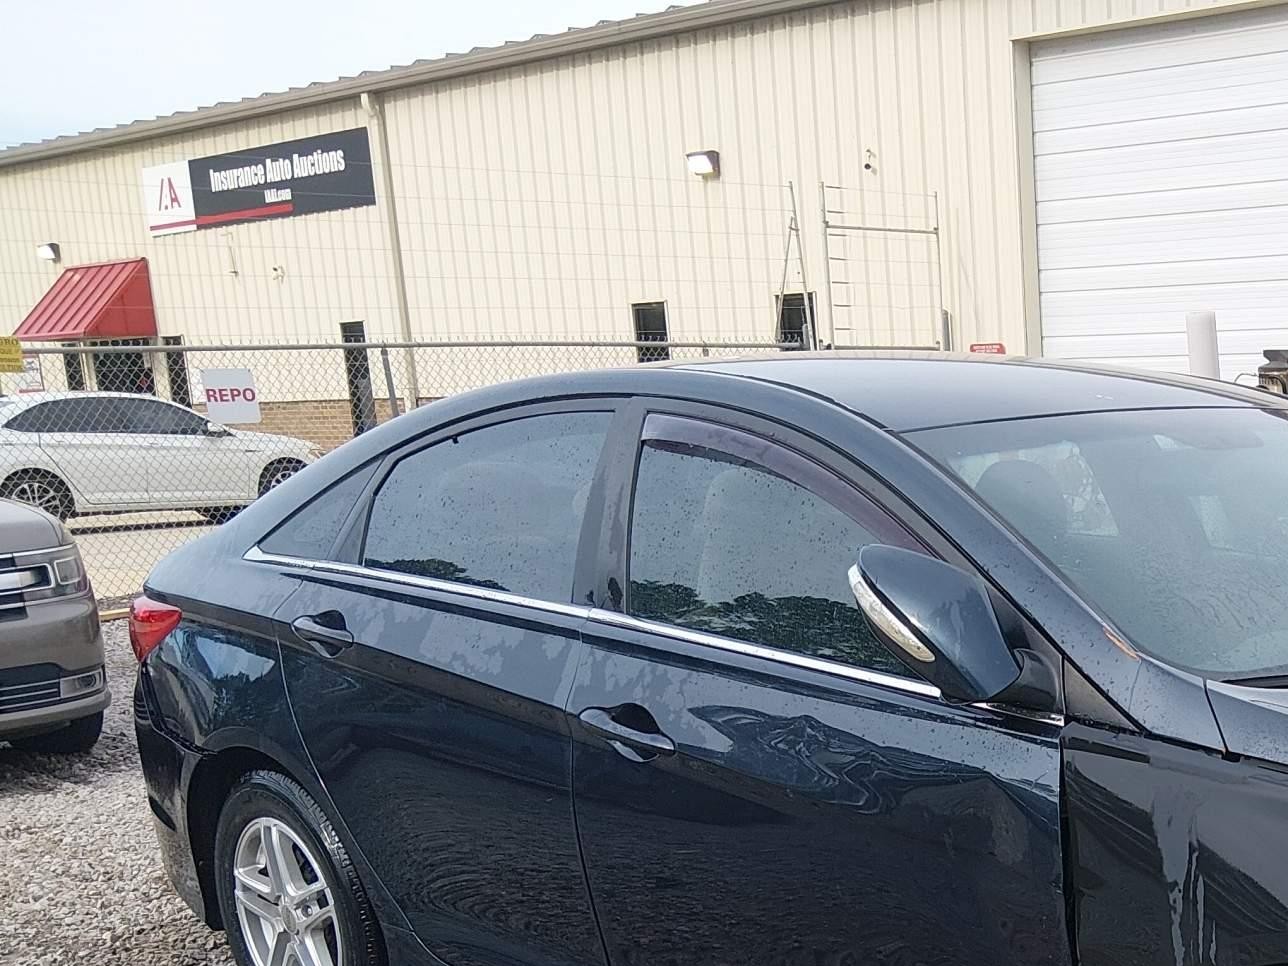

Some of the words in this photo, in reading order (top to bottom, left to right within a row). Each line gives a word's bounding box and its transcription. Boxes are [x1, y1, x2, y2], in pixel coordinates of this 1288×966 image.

[209, 164, 265, 192] Insurance
[265, 158, 292, 183] Auto
[292, 149, 345, 179] Auctions
[205, 387, 256, 402] REPO
